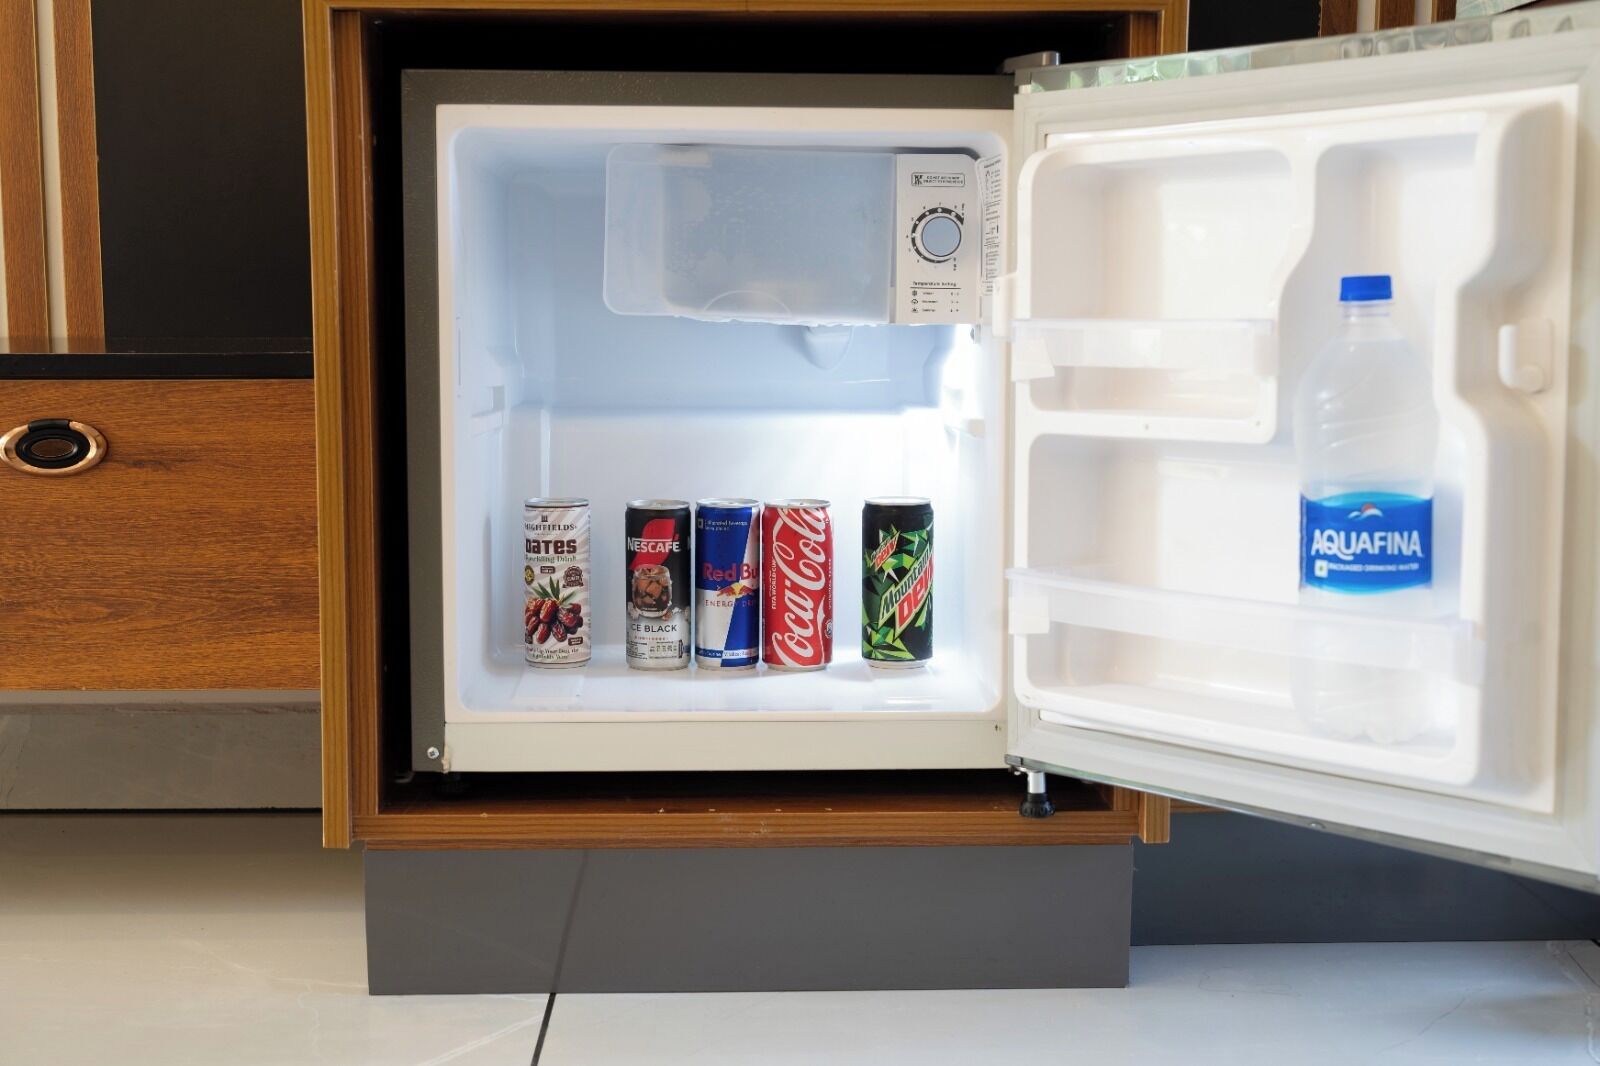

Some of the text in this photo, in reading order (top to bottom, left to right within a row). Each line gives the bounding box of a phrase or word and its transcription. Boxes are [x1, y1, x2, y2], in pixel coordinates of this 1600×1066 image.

[1310, 528, 1424, 561] AQUAFINA
[703, 562, 758, 581] Red Bu
[881, 548, 931, 620] Mountain
[644, 624, 678, 633] BLACK
